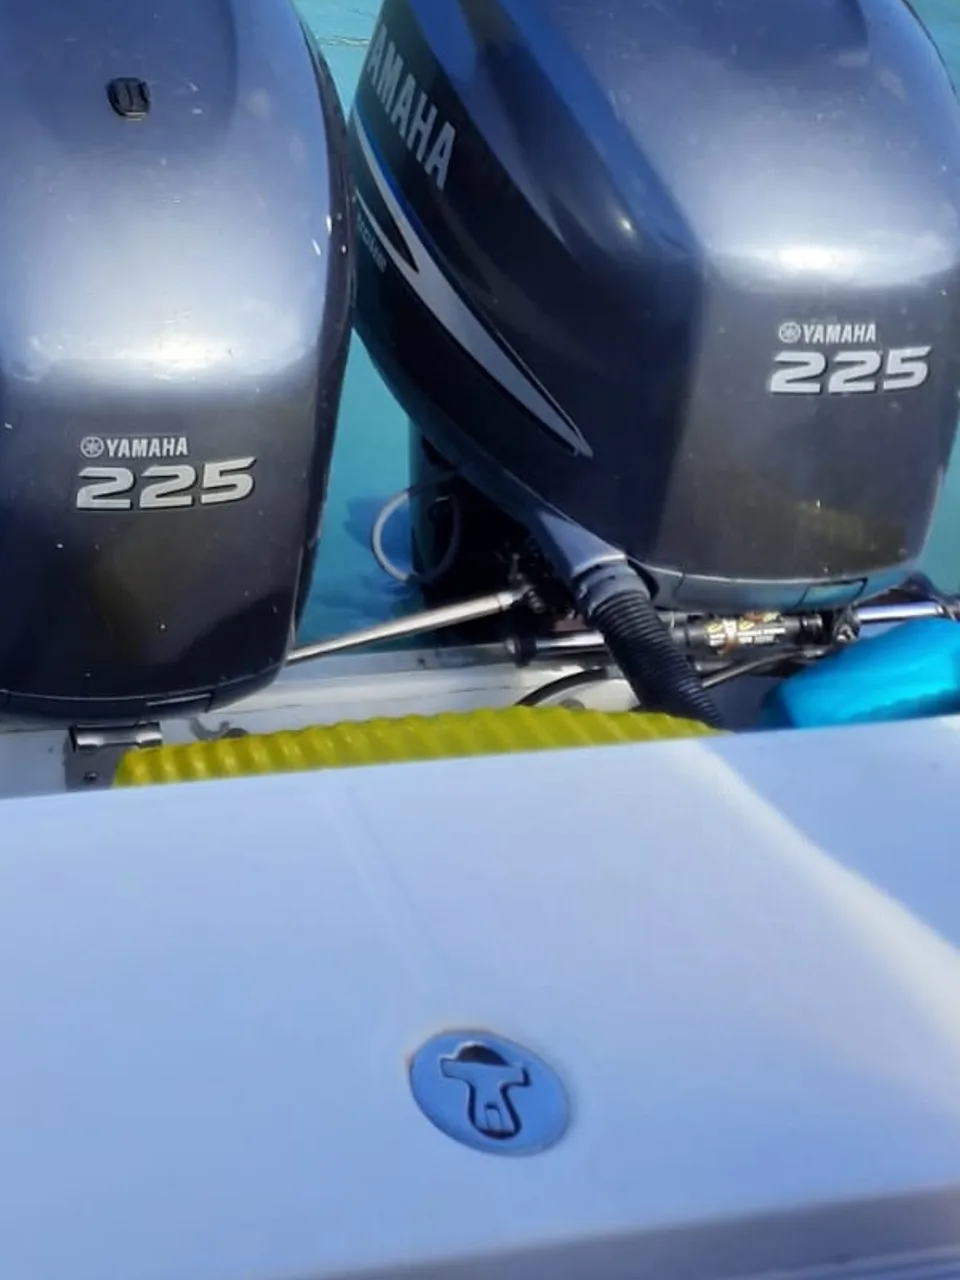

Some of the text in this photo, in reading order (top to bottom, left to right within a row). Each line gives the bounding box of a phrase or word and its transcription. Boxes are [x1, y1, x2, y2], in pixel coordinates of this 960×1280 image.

[366, 23, 456, 191] AMAHA
[803, 322, 877, 345] YAMAHA
[770, 345, 932, 395] 225
[106, 436, 189, 458] YAMAHA
[77, 456, 257, 510] 225
